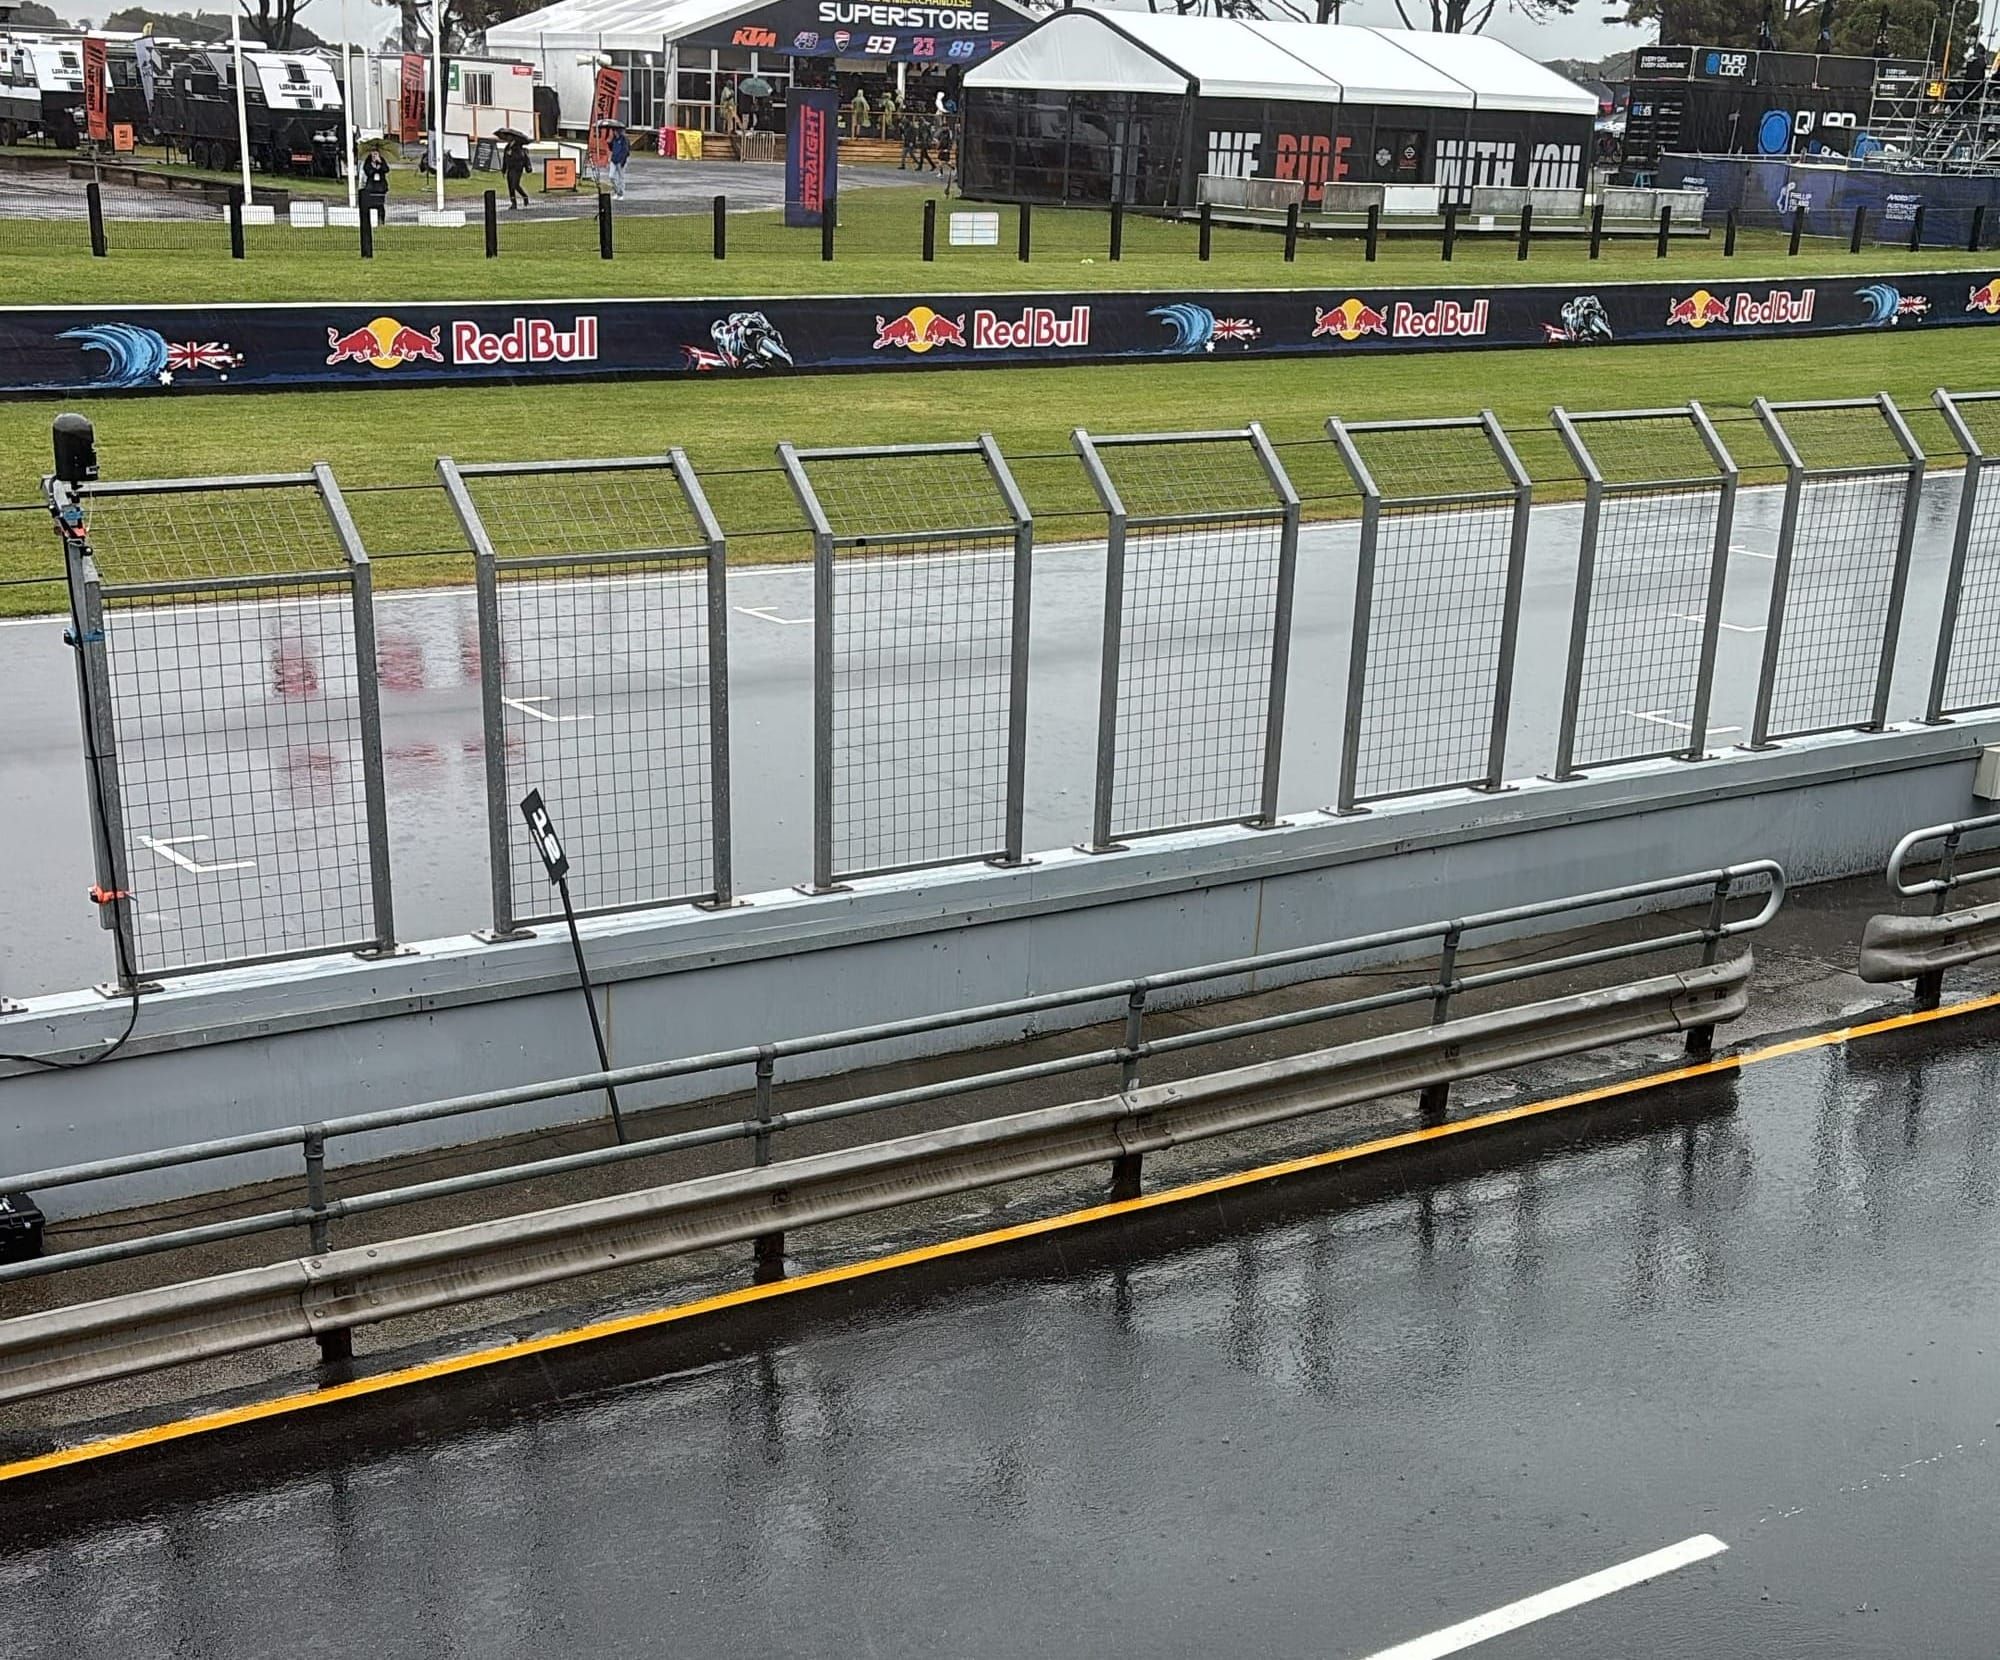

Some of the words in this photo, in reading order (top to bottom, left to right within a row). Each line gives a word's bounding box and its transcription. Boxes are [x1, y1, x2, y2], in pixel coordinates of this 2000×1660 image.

[818, 2, 989, 31] SUPERSTORE
[891, 0, 972, 8] HANDISE
[732, 27, 776, 47] KTM
[865, 36, 897, 54] 93
[913, 37, 935, 56] 23
[948, 41, 975, 57] 89
[1719, 65, 1747, 77] LOCK
[88, 64, 97, 111] URBAN
[804, 105, 820, 212] STRAIGHT
[1208, 131, 1262, 178] WE
[1275, 134, 1352, 201] RIDE
[1435, 140, 1516, 204] WITH
[1529, 143, 1582, 188] YOU
